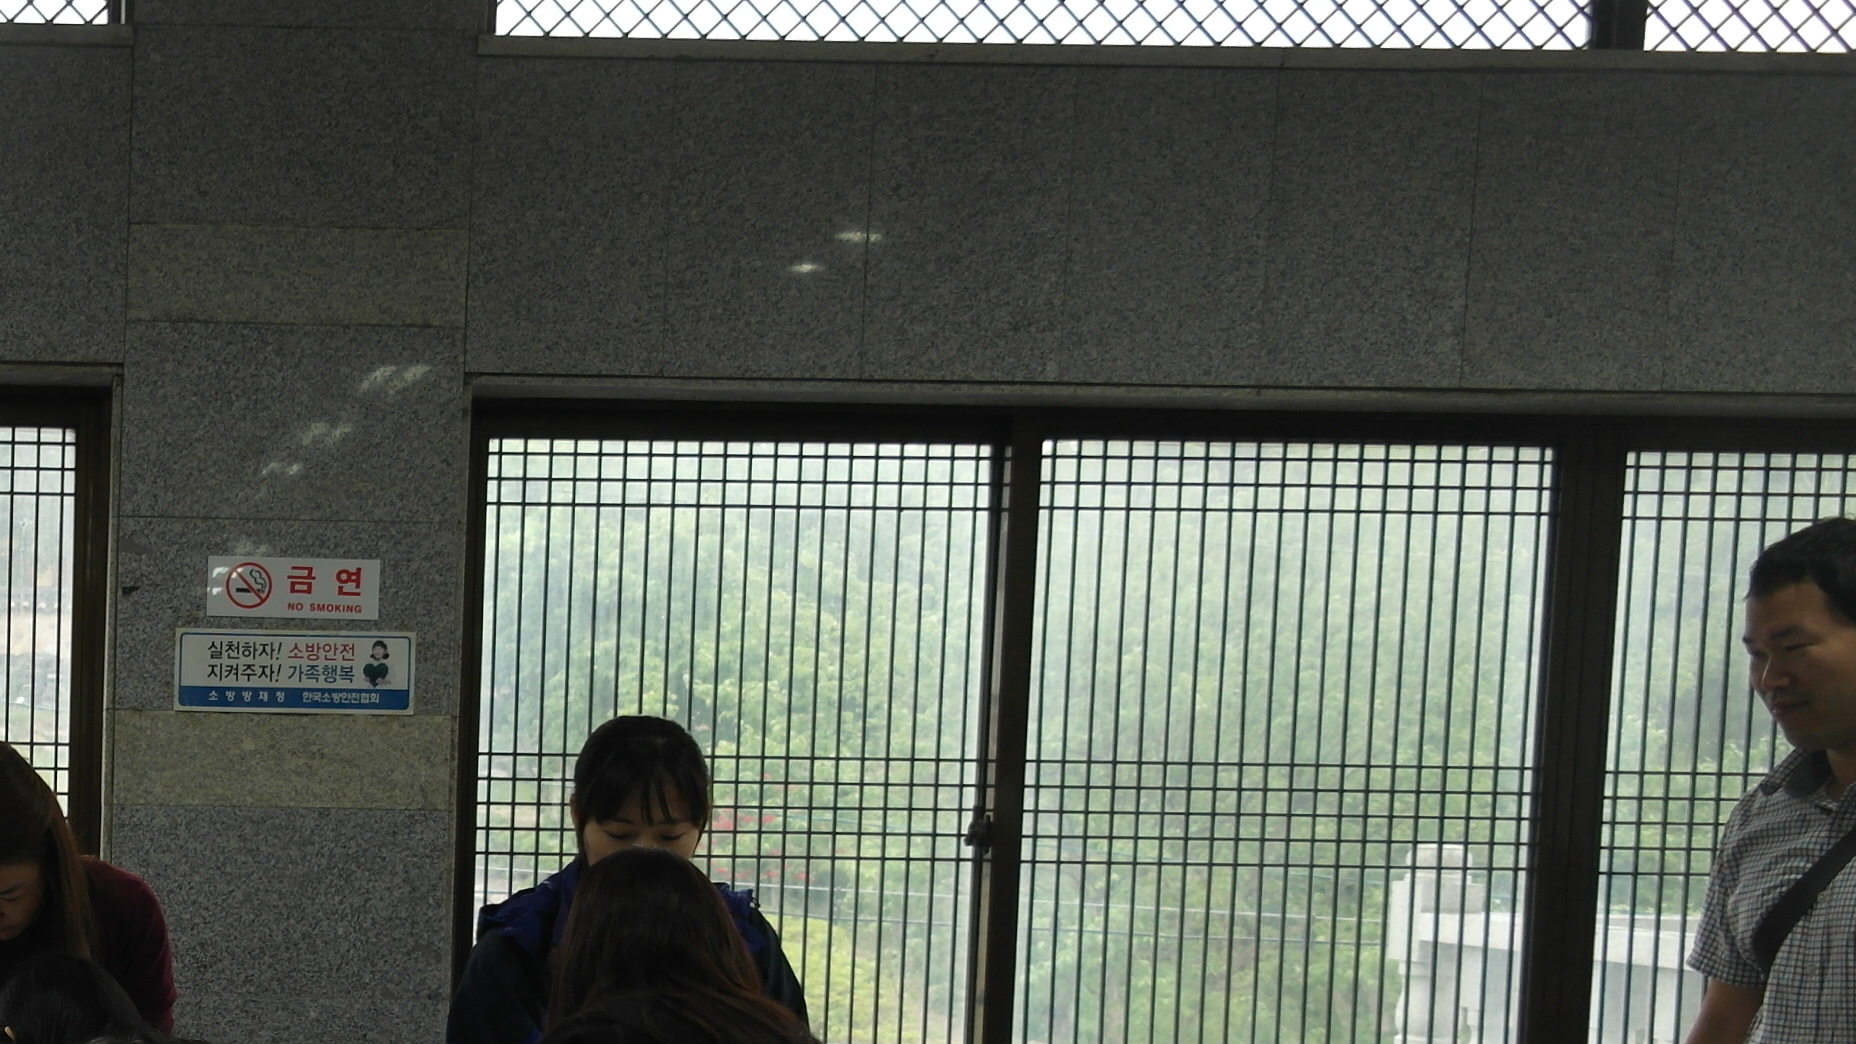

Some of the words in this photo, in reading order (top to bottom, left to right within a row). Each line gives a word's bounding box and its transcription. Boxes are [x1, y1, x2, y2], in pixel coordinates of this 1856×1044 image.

[287, 602, 304, 612] NO
[309, 603, 363, 614] SMOKING
[207, 640, 283, 661] 실천하자!
[287, 642, 356, 662] 소방안전
[207, 663, 282, 683] 지켜주자!
[287, 665, 356, 684] 가족행복
[302, 691, 380, 704] 한국소방안전협회
